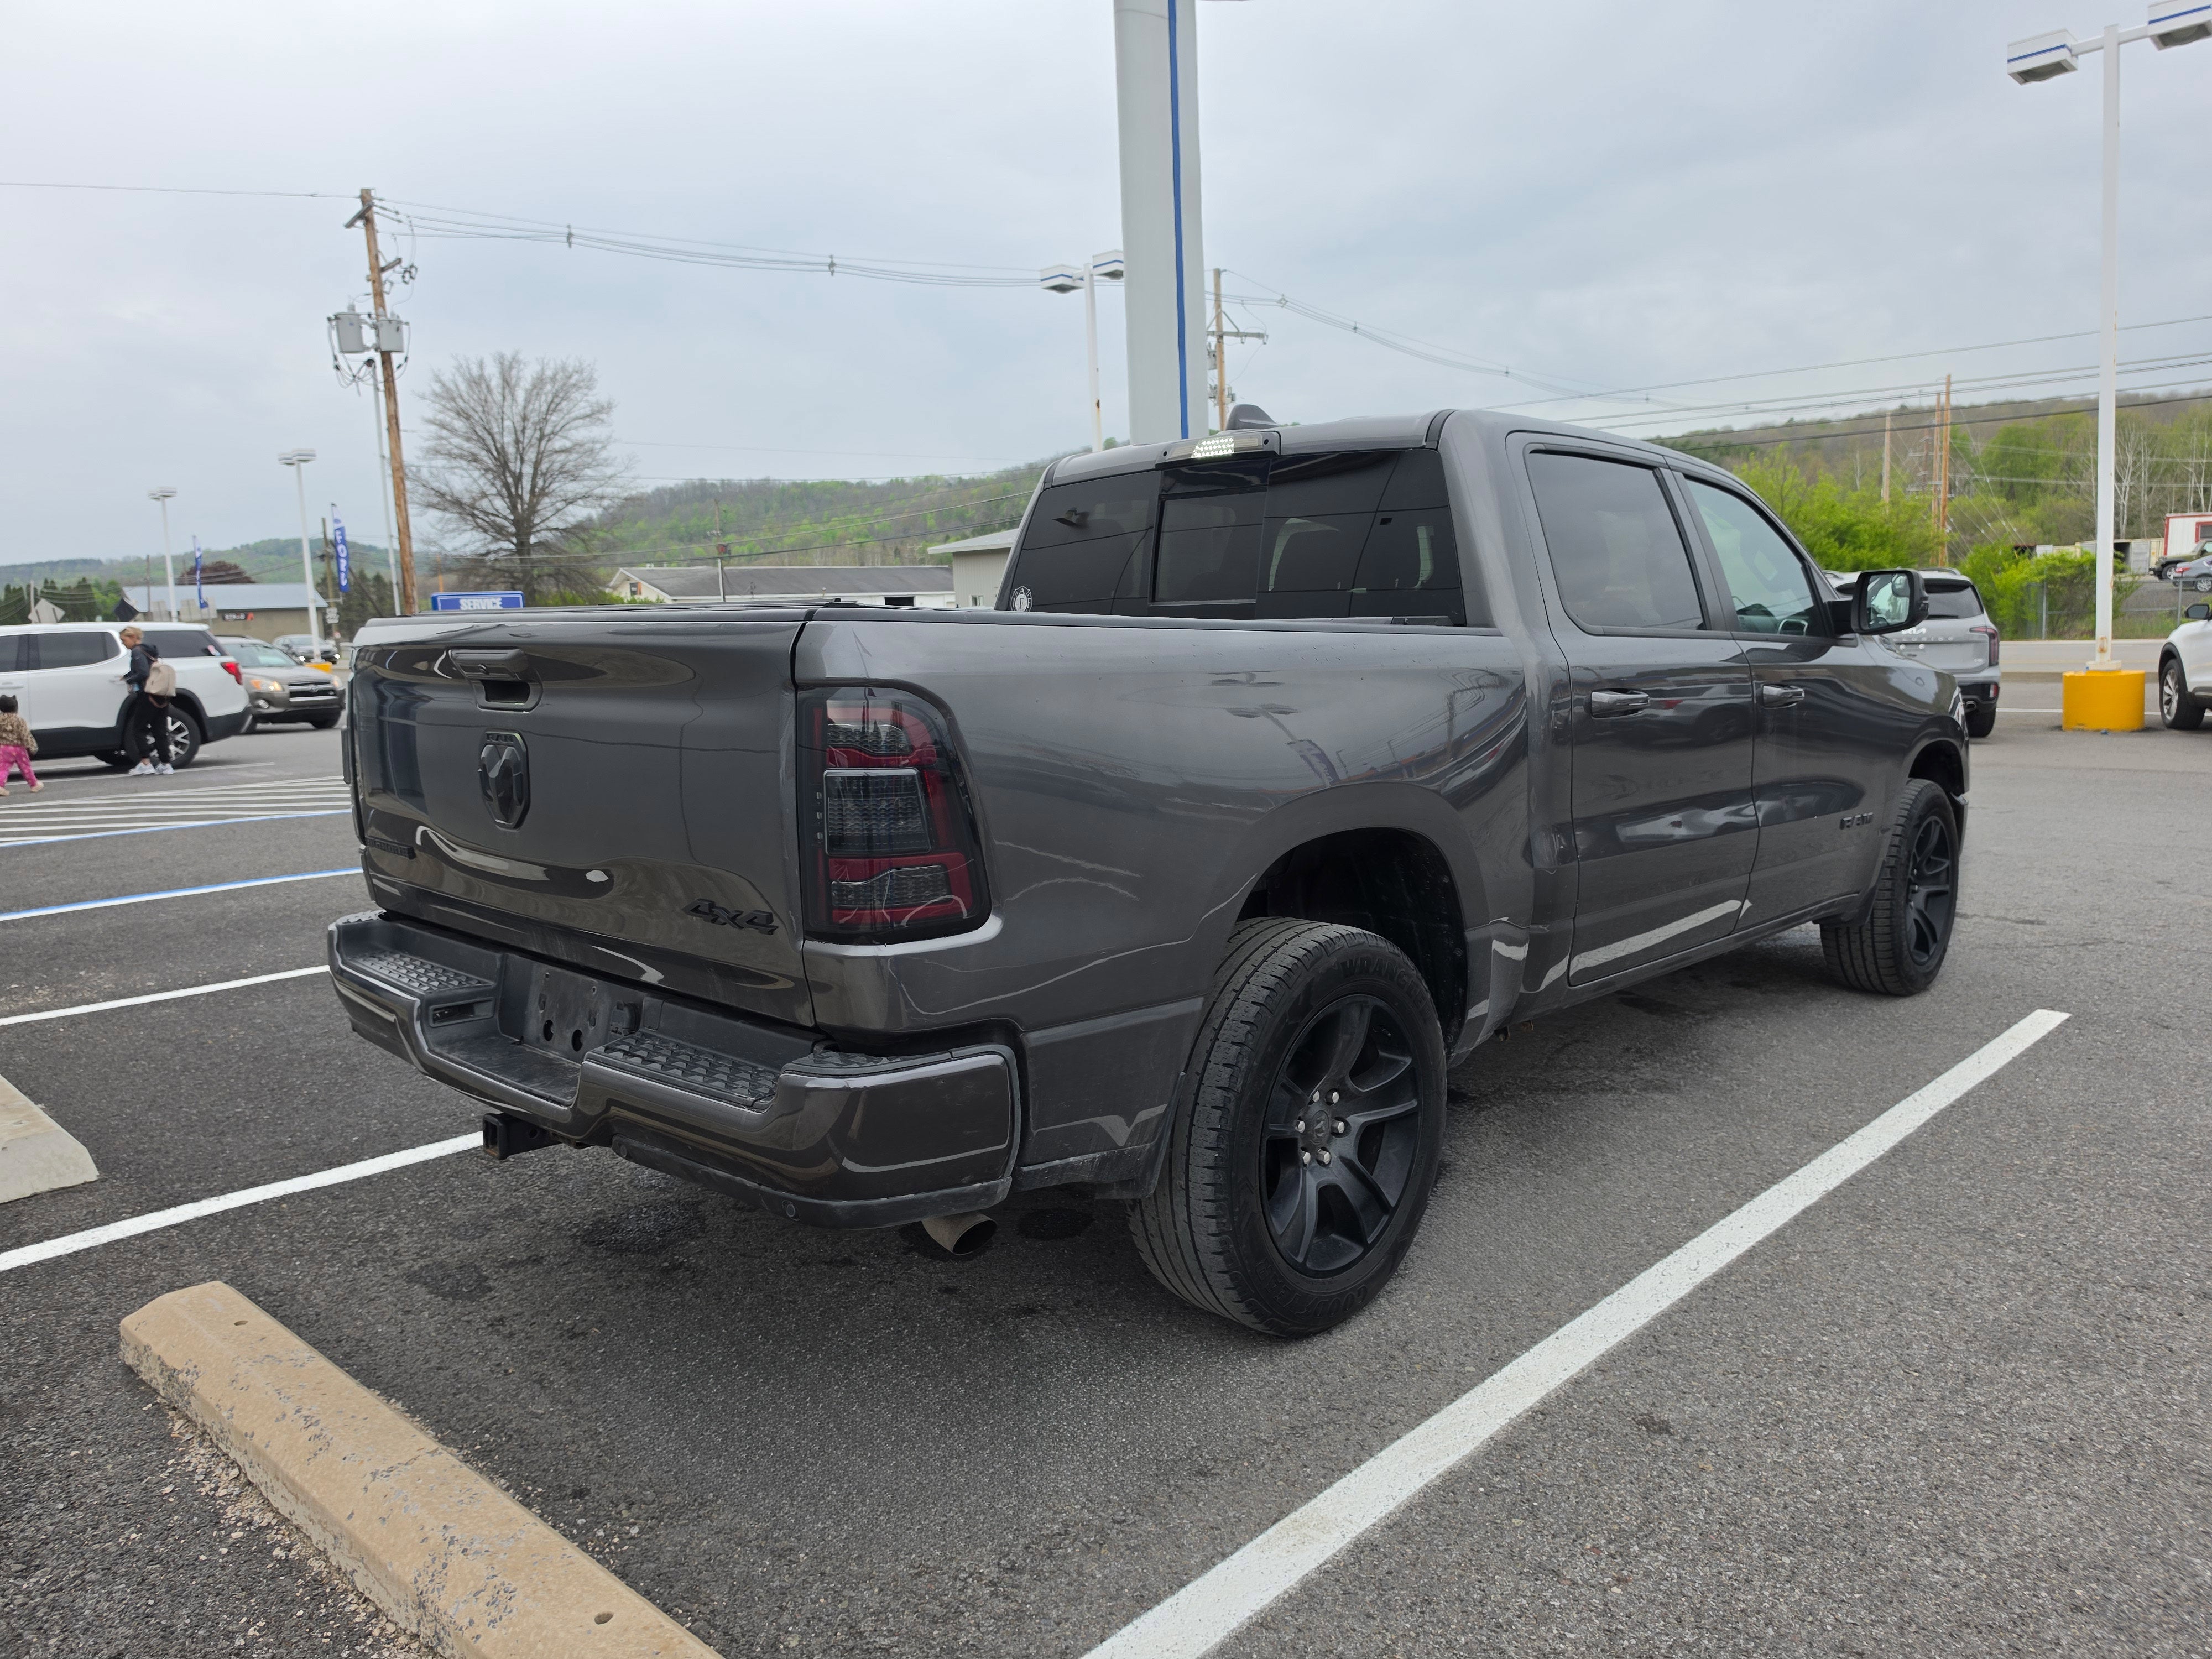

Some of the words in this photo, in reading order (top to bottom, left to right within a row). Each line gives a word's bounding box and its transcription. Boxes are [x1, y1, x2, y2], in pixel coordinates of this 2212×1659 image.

[460, 598, 503, 611] SERVICE
[486, 733, 514, 743] RAM
[1839, 812, 1874, 830] RAM
[1255, 1258, 1368, 1319] GOODYEAR
